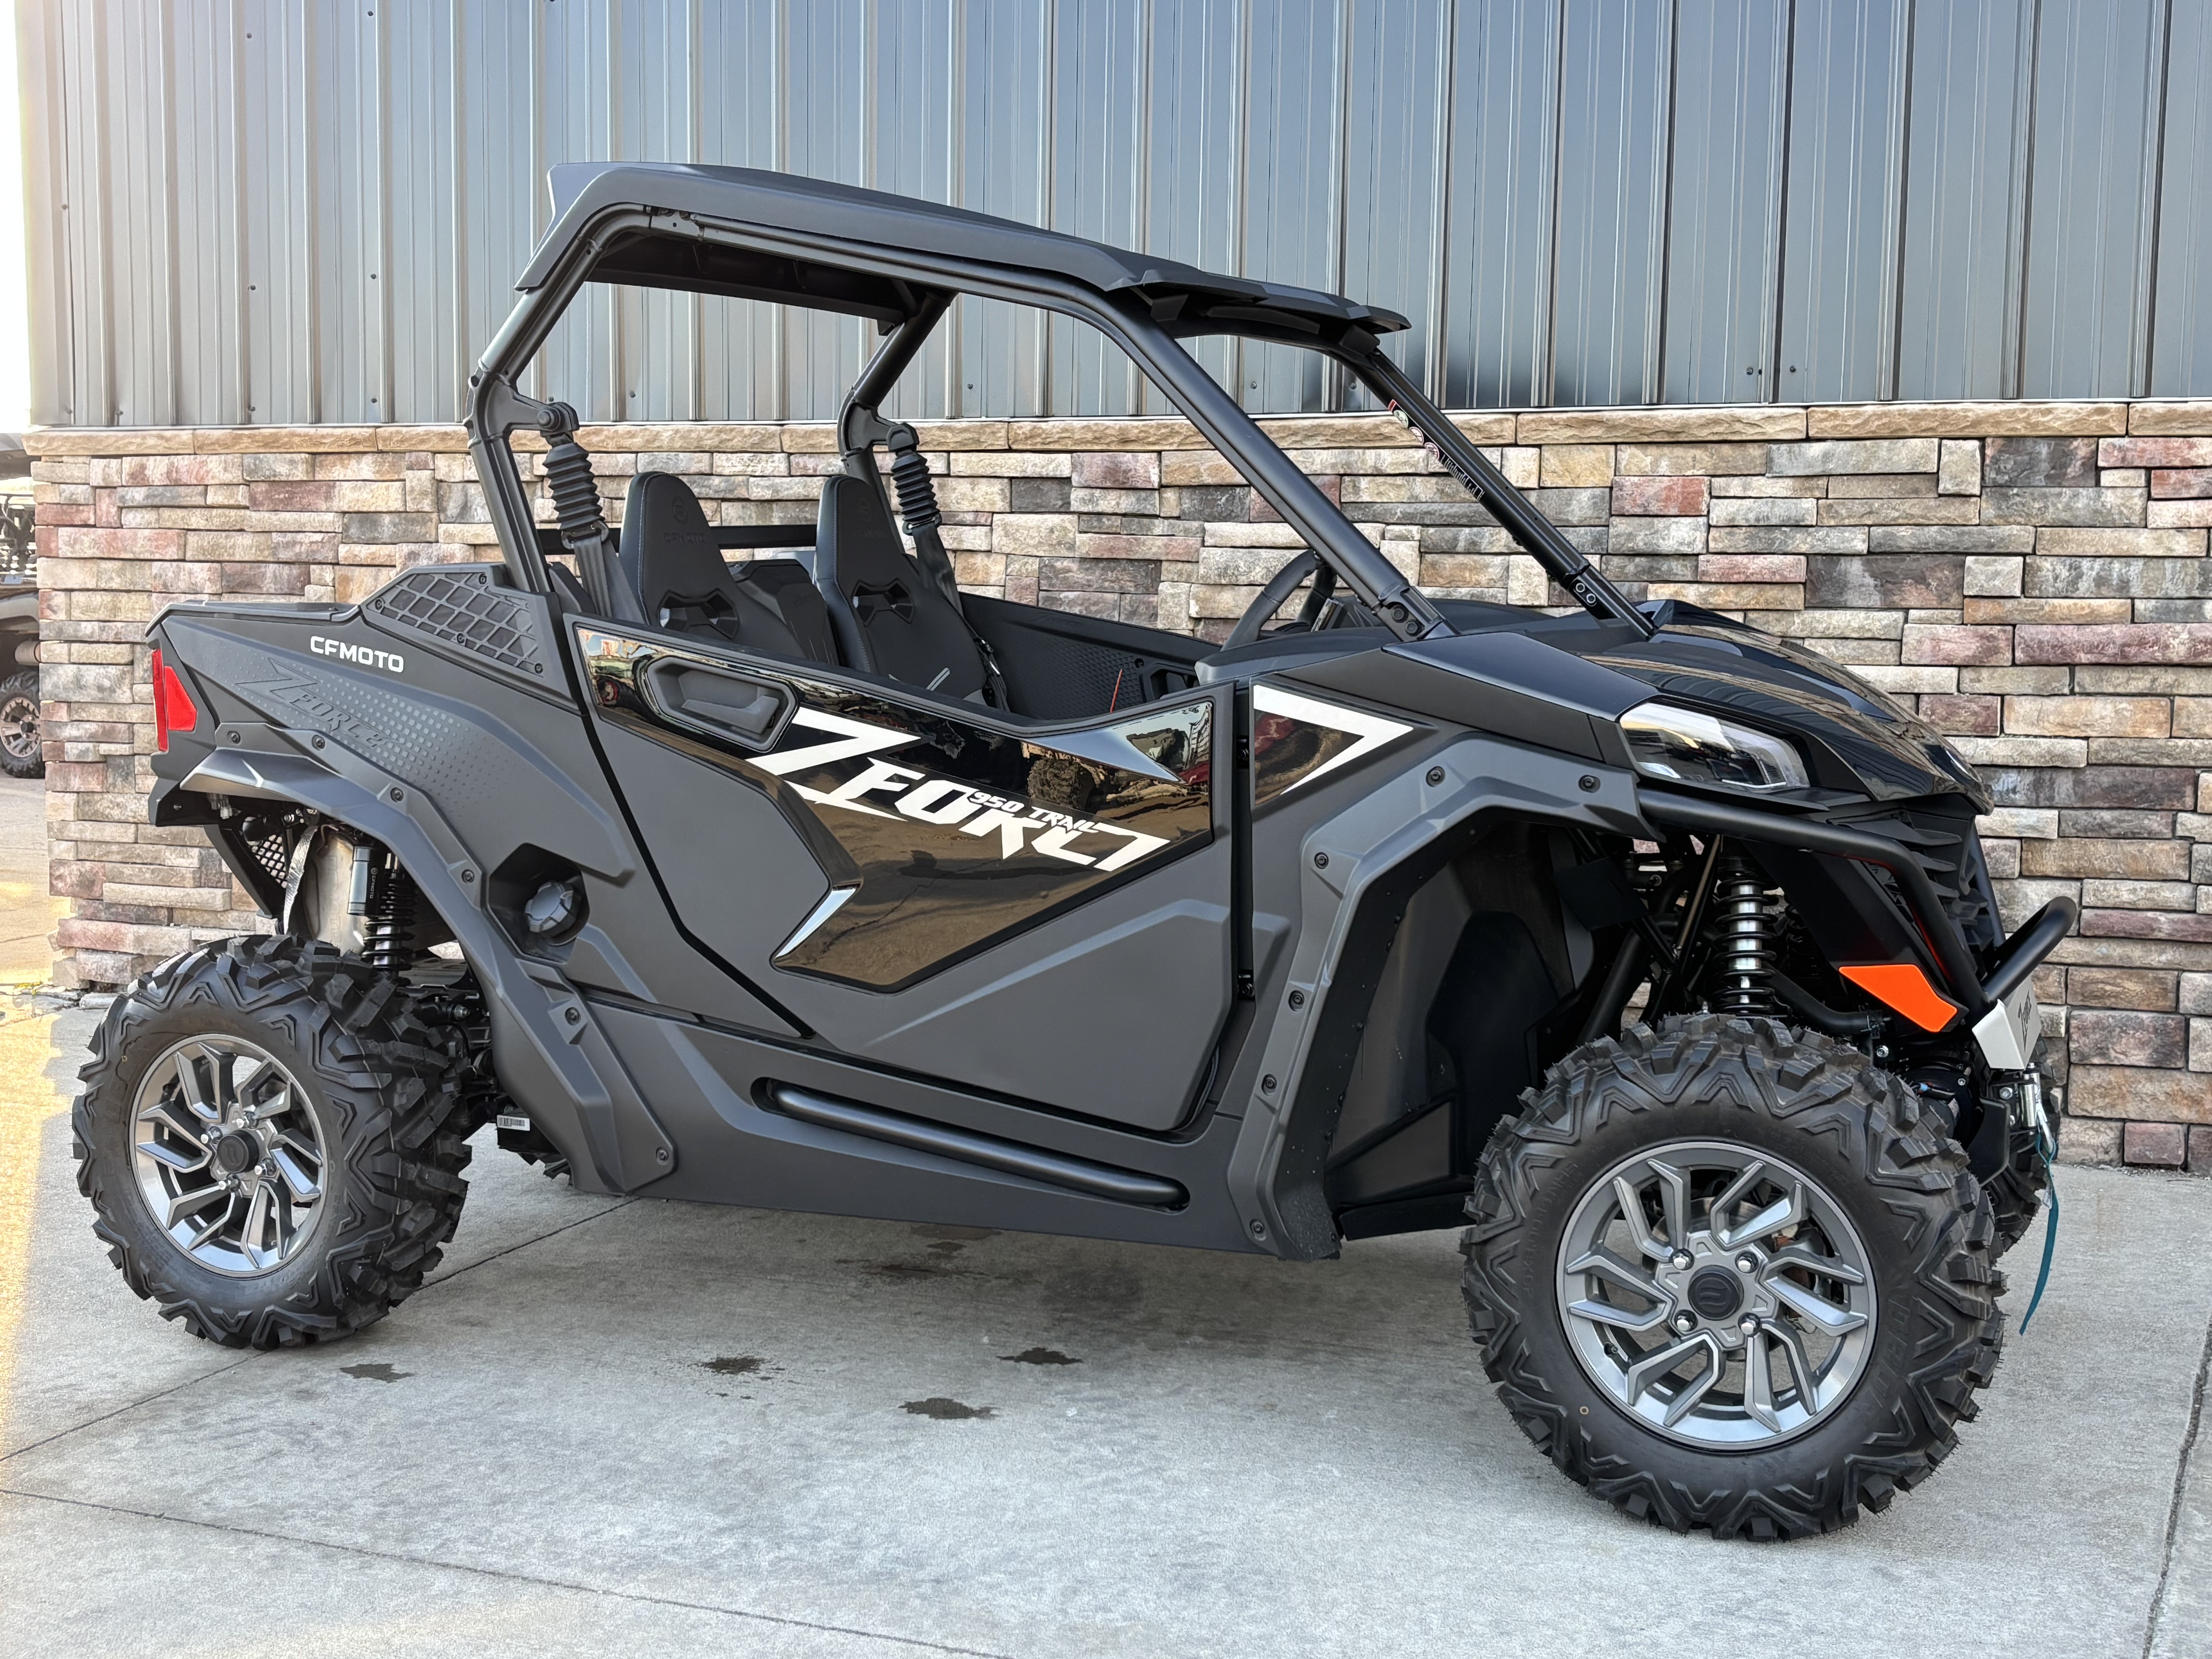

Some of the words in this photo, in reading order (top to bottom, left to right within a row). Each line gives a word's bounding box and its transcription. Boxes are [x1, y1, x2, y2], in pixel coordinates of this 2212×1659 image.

[310, 635, 404, 673] CFMOTO
[970, 791, 1025, 812] 950
[1029, 806, 1100, 833] TRAIL
